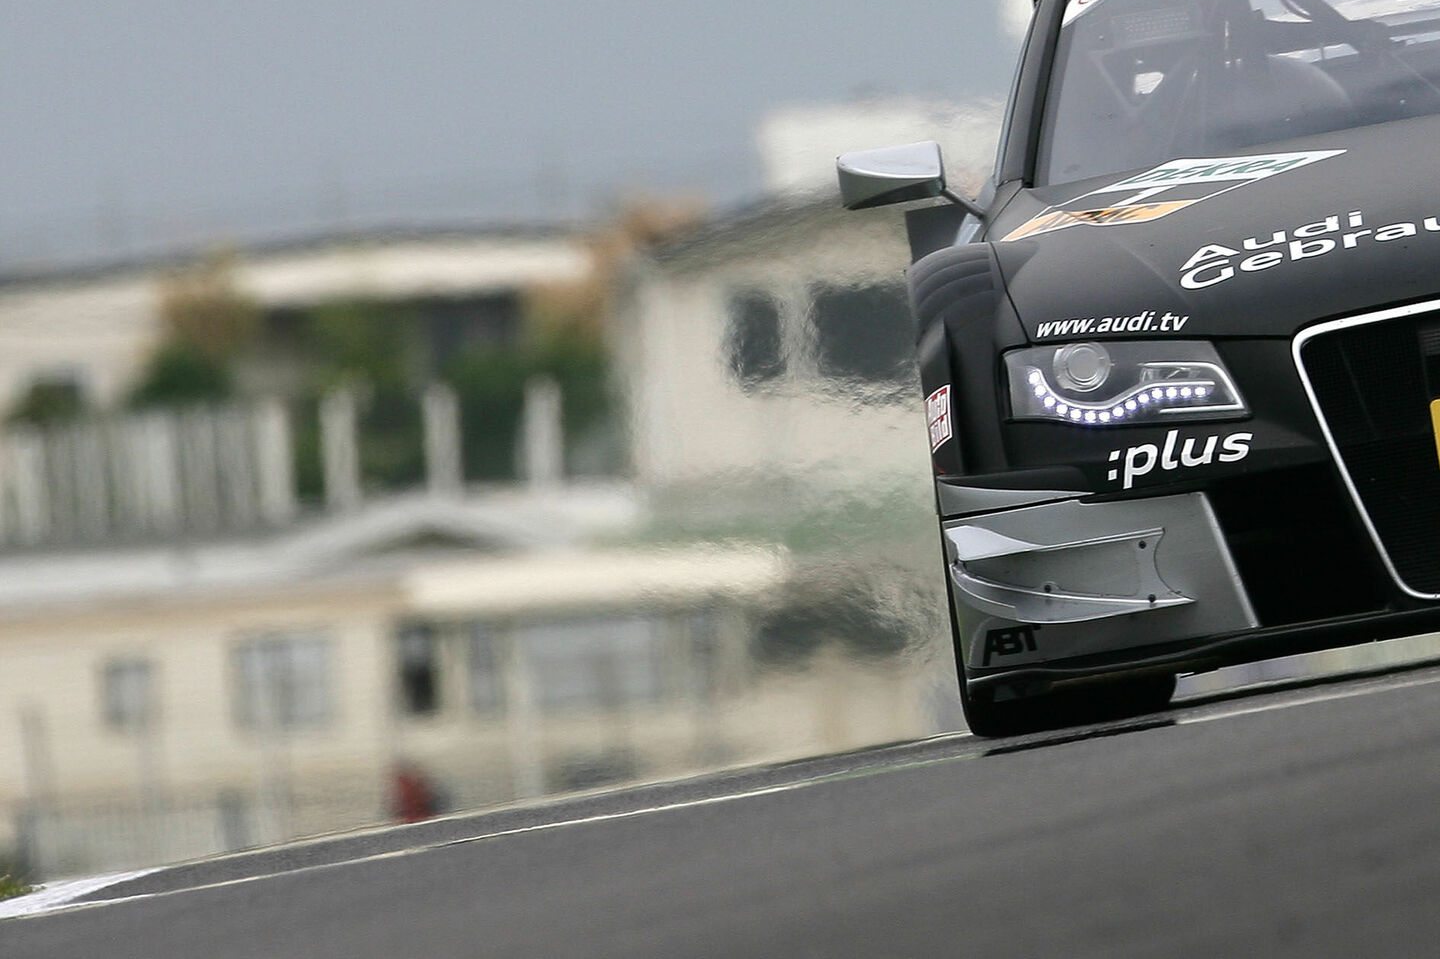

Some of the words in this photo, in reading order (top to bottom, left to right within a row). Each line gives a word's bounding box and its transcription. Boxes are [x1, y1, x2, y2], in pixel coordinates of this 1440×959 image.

[1116, 155, 1310, 187] DEKRA
[1178, 210, 1366, 271] Audi
[1034, 310, 1190, 339] www.audi.tv
[982, 623, 1042, 668] ABT
